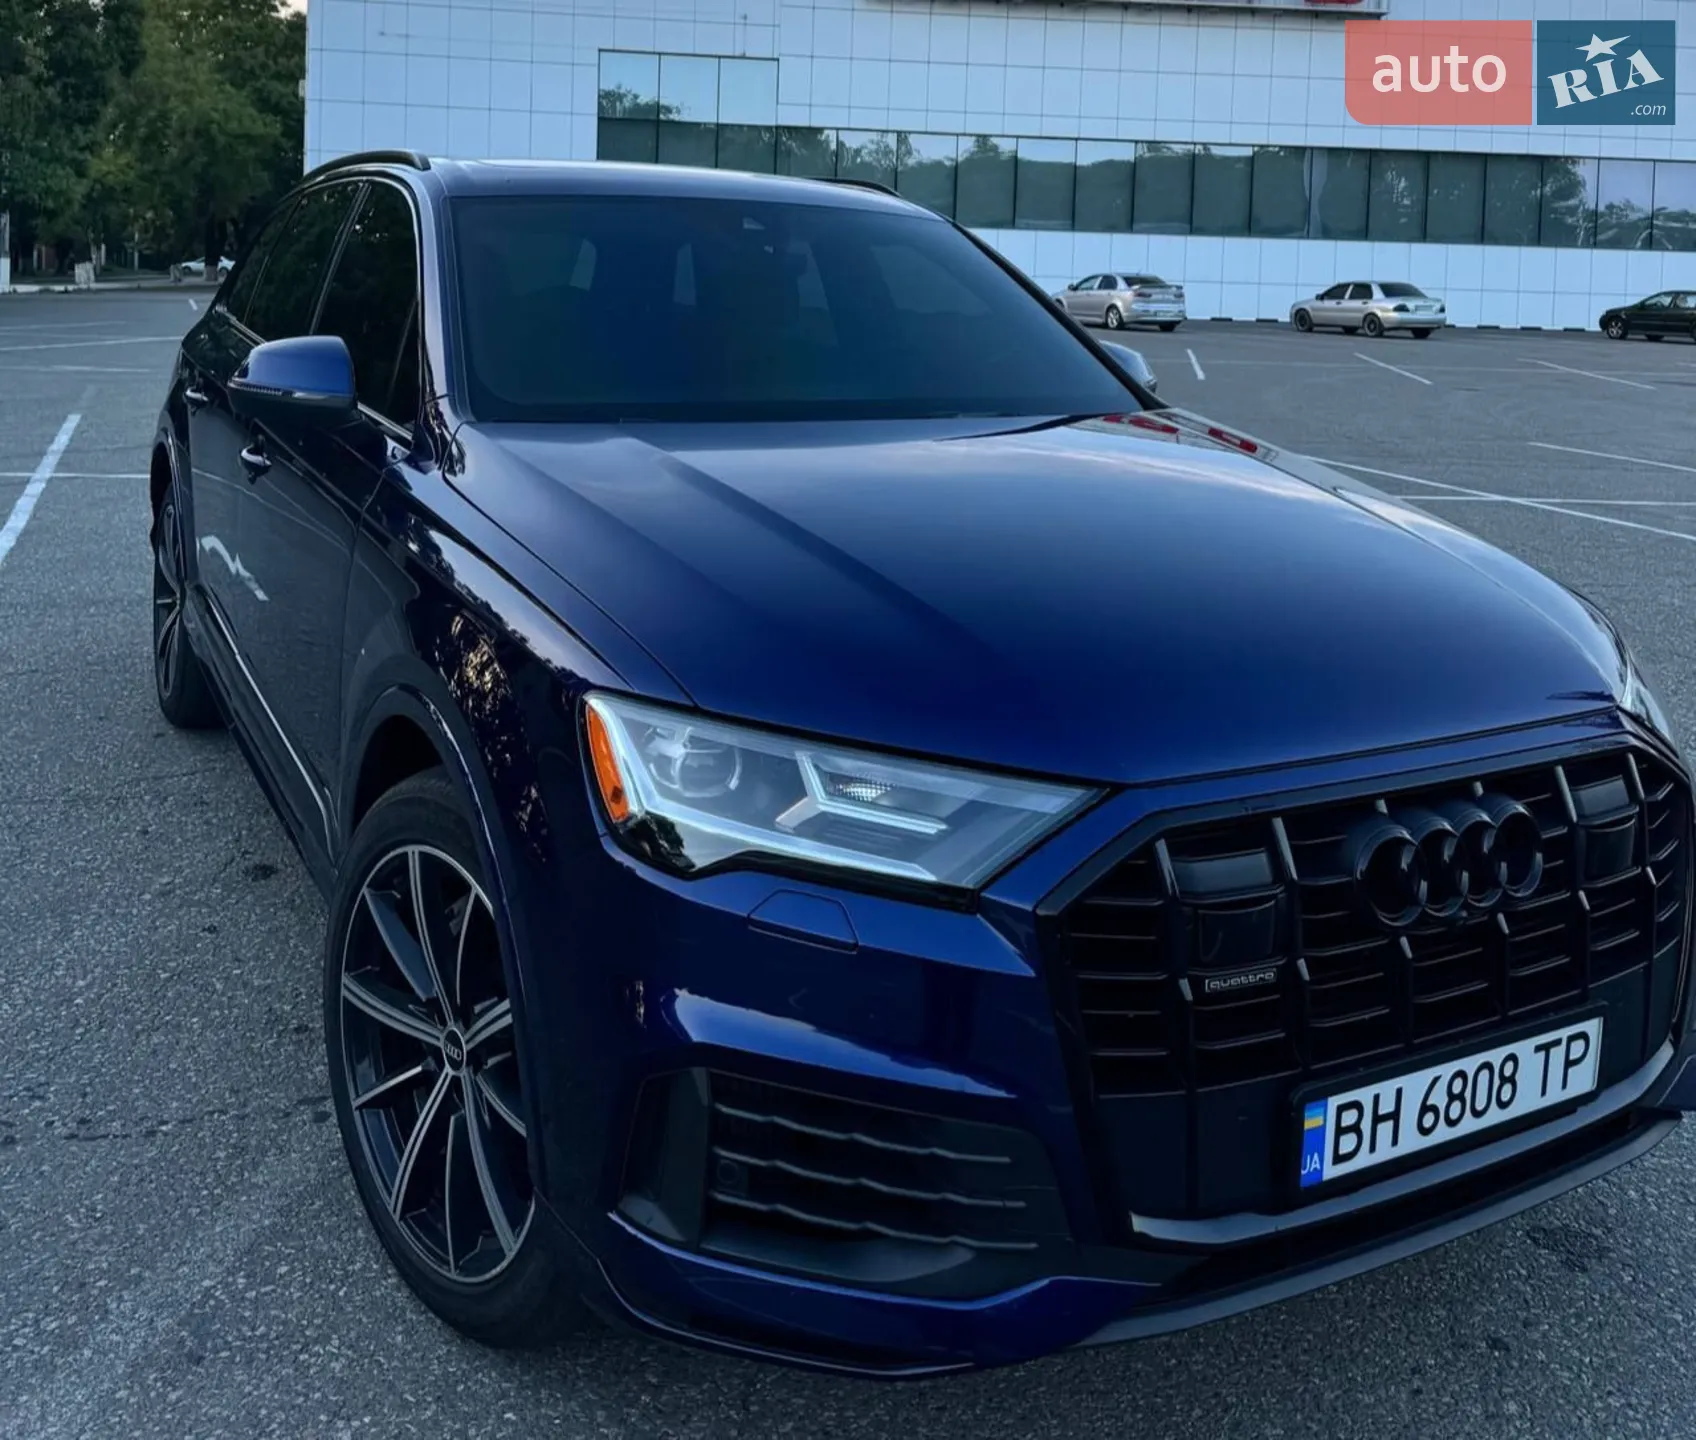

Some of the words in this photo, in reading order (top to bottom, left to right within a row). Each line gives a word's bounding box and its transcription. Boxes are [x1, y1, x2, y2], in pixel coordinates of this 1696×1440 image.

[1331, 1086, 1403, 1166] BH
[1416, 1052, 1519, 1138] 6808
[1533, 1030, 1591, 1098] TP
